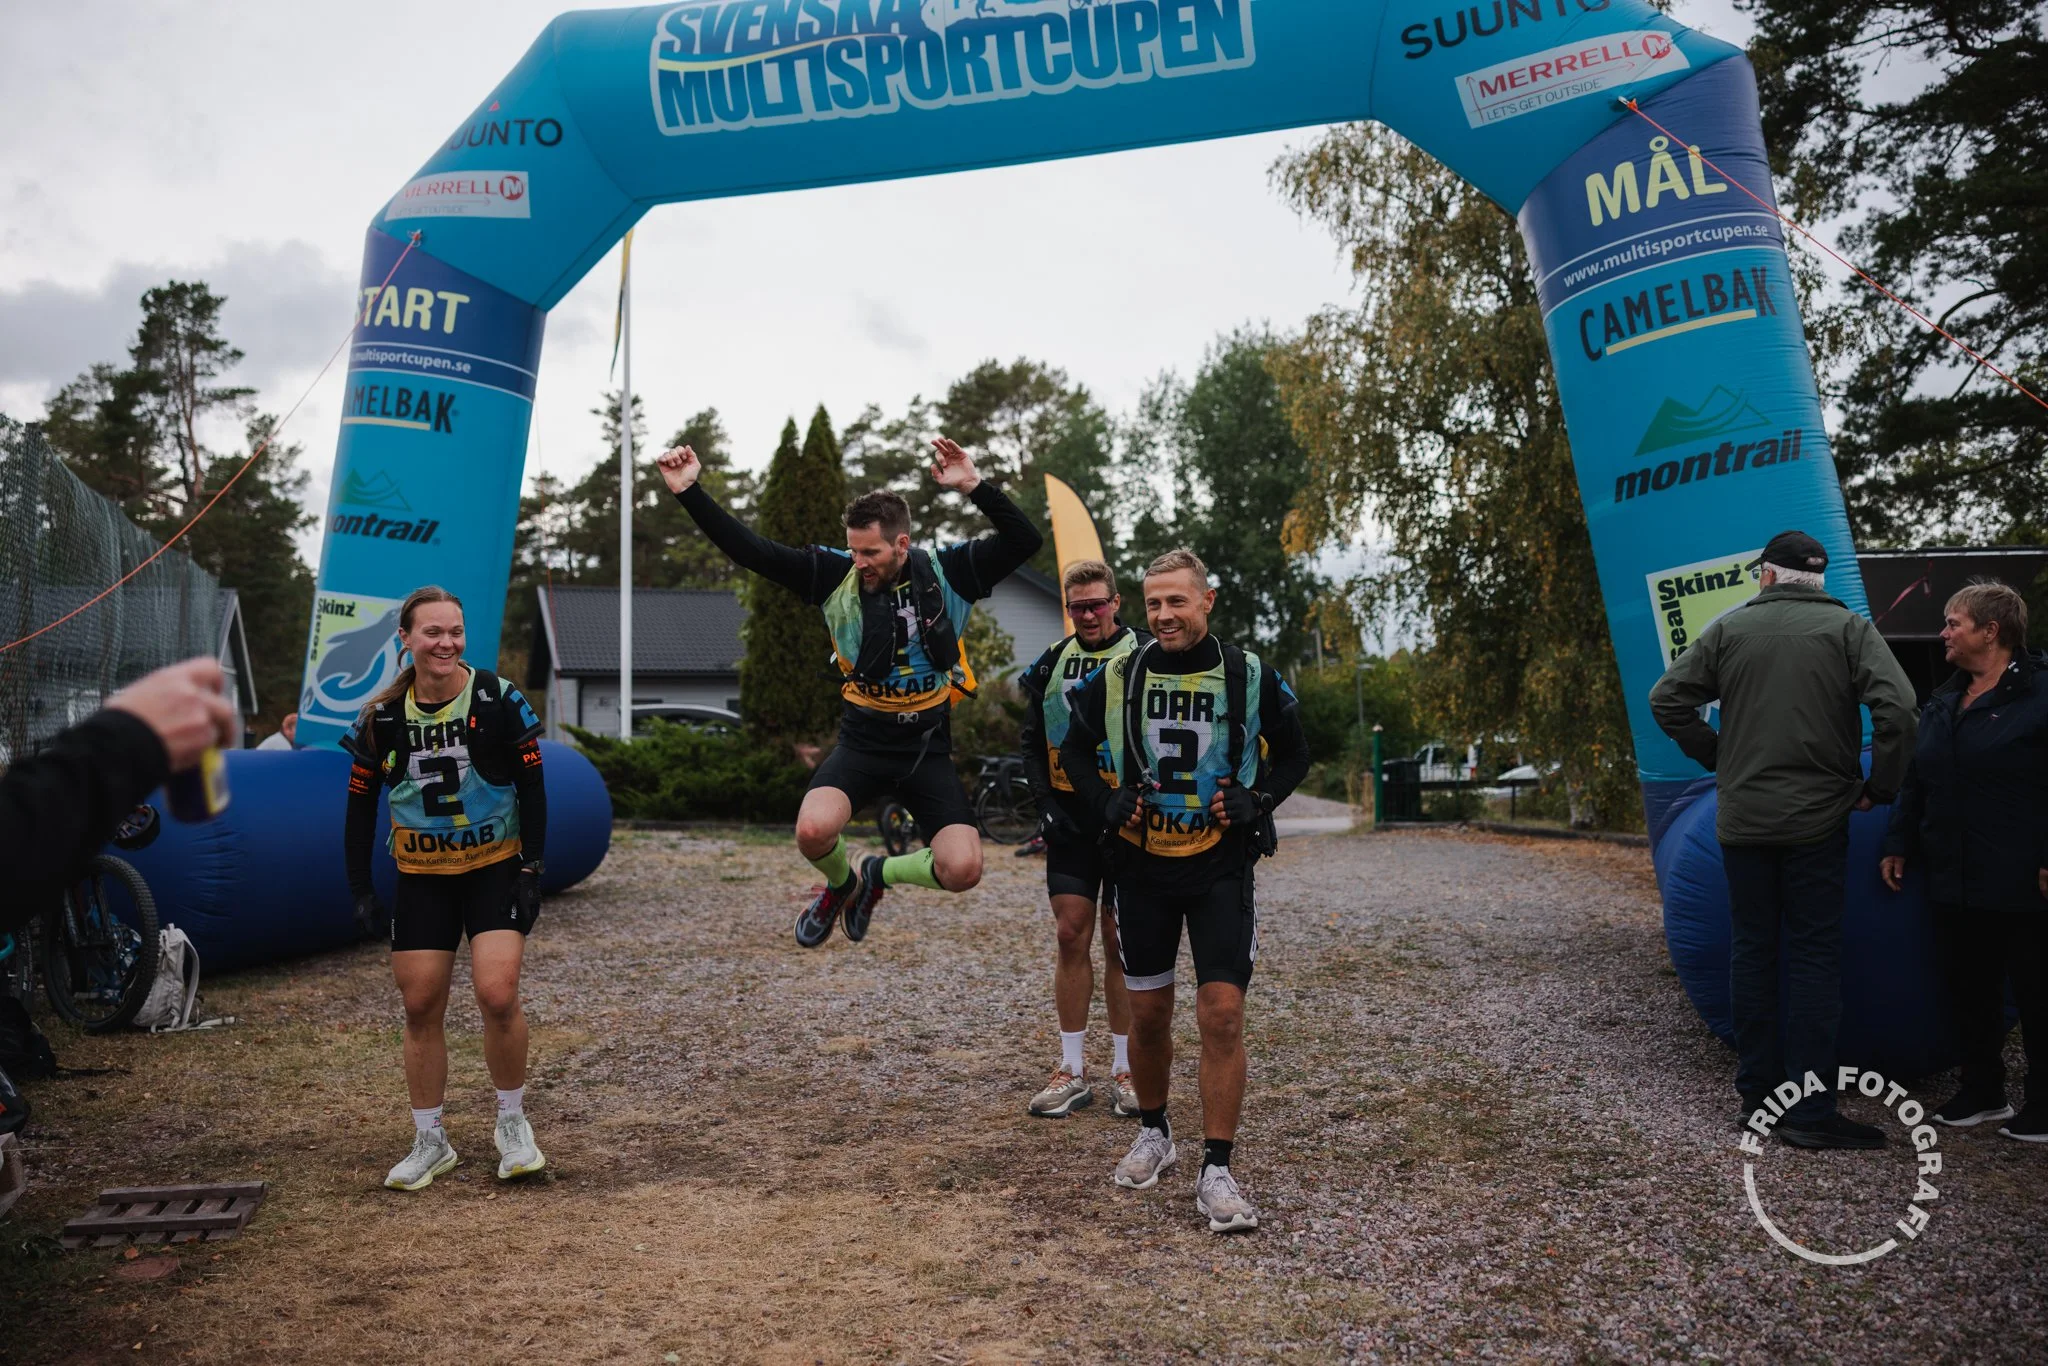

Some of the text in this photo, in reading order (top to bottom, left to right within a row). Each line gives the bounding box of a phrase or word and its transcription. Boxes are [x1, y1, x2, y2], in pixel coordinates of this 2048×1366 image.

[659, 2, 1246, 127] MULTISPORTCUPEN
[1479, 40, 1643, 99] MERRELL
[1487, 79, 1601, 121] LET'S GET OUTSIDE
[1585, 135, 1728, 227] MÅL
[1563, 222, 1769, 288] www.multisportcupen.se
[357, 285, 470, 334] TART
[1580, 266, 1778, 362] CAMELBAK
[352, 384, 456, 434] MELBAK
[1614, 429, 1802, 504] montrail
[331, 513, 440, 545] ontrail
[1658, 567, 1744, 602] Skinz
[1063, 653, 1112, 679] ÖA
[1147, 683, 1215, 722] ÖAR
[419, 756, 464, 817] 2
[1158, 728, 1198, 795] 2
[404, 823, 496, 853] JOKAB
[1149, 808, 1206, 834] OKA
